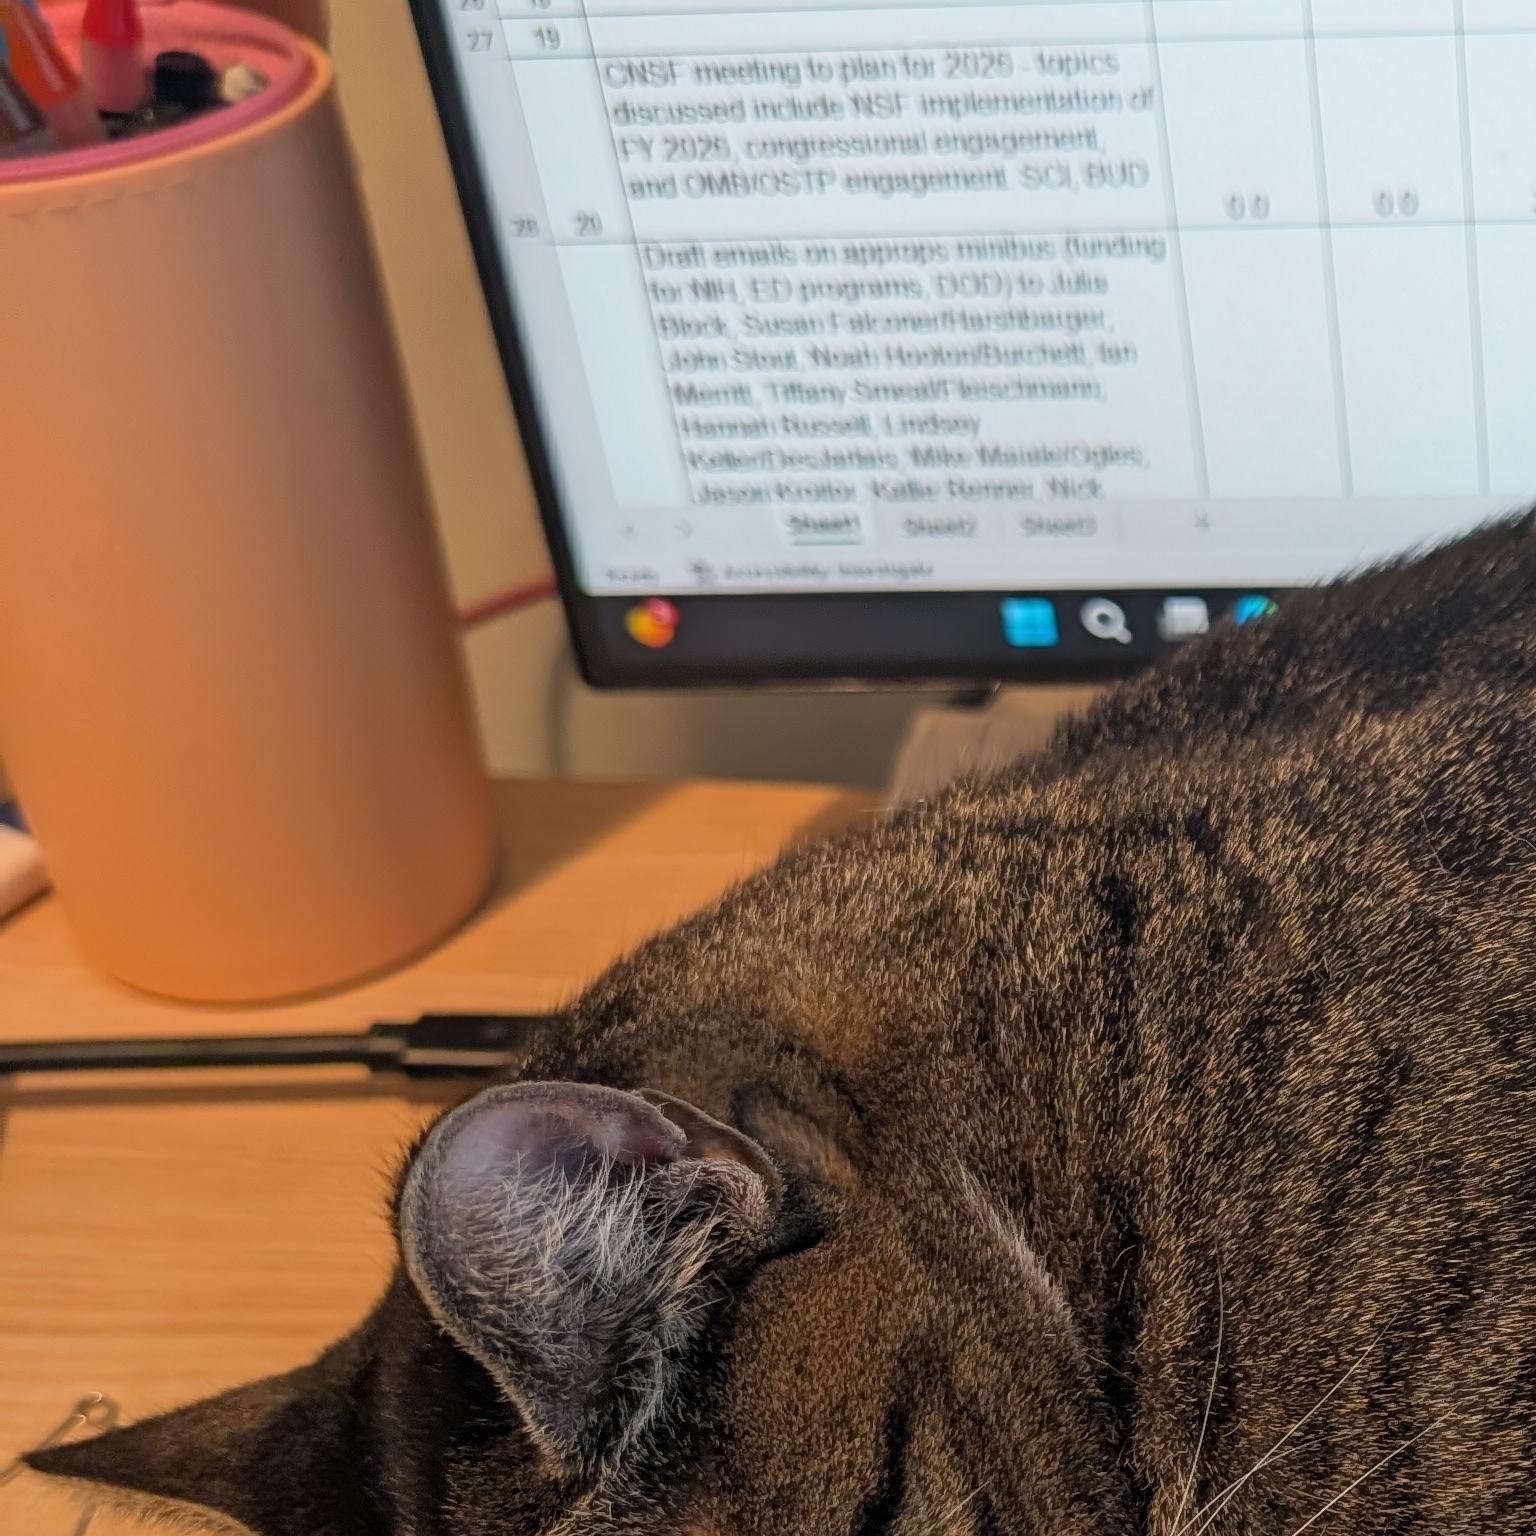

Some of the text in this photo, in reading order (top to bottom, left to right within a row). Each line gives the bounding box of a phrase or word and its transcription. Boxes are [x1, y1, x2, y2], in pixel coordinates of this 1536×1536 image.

[466, 30, 494, 52] 27
[532, 25, 561, 51] 19
[604, 58, 682, 92] CNSF
[692, 54, 801, 91] meeting
[808, 54, 835, 83] to
[841, 52, 897, 87] plan
[901, 50, 937, 80] for
[1034, 50, 1121, 80] topics
[611, 96, 747, 128] discussed
[752, 92, 845, 123] include
[850, 88, 912, 120] NSF
[1129, 84, 1155, 112] of
[620, 135, 656, 166] FY
[744, 130, 928, 163] congressional
[628, 172, 678, 204] and
[645, 242, 706, 271] Draft
